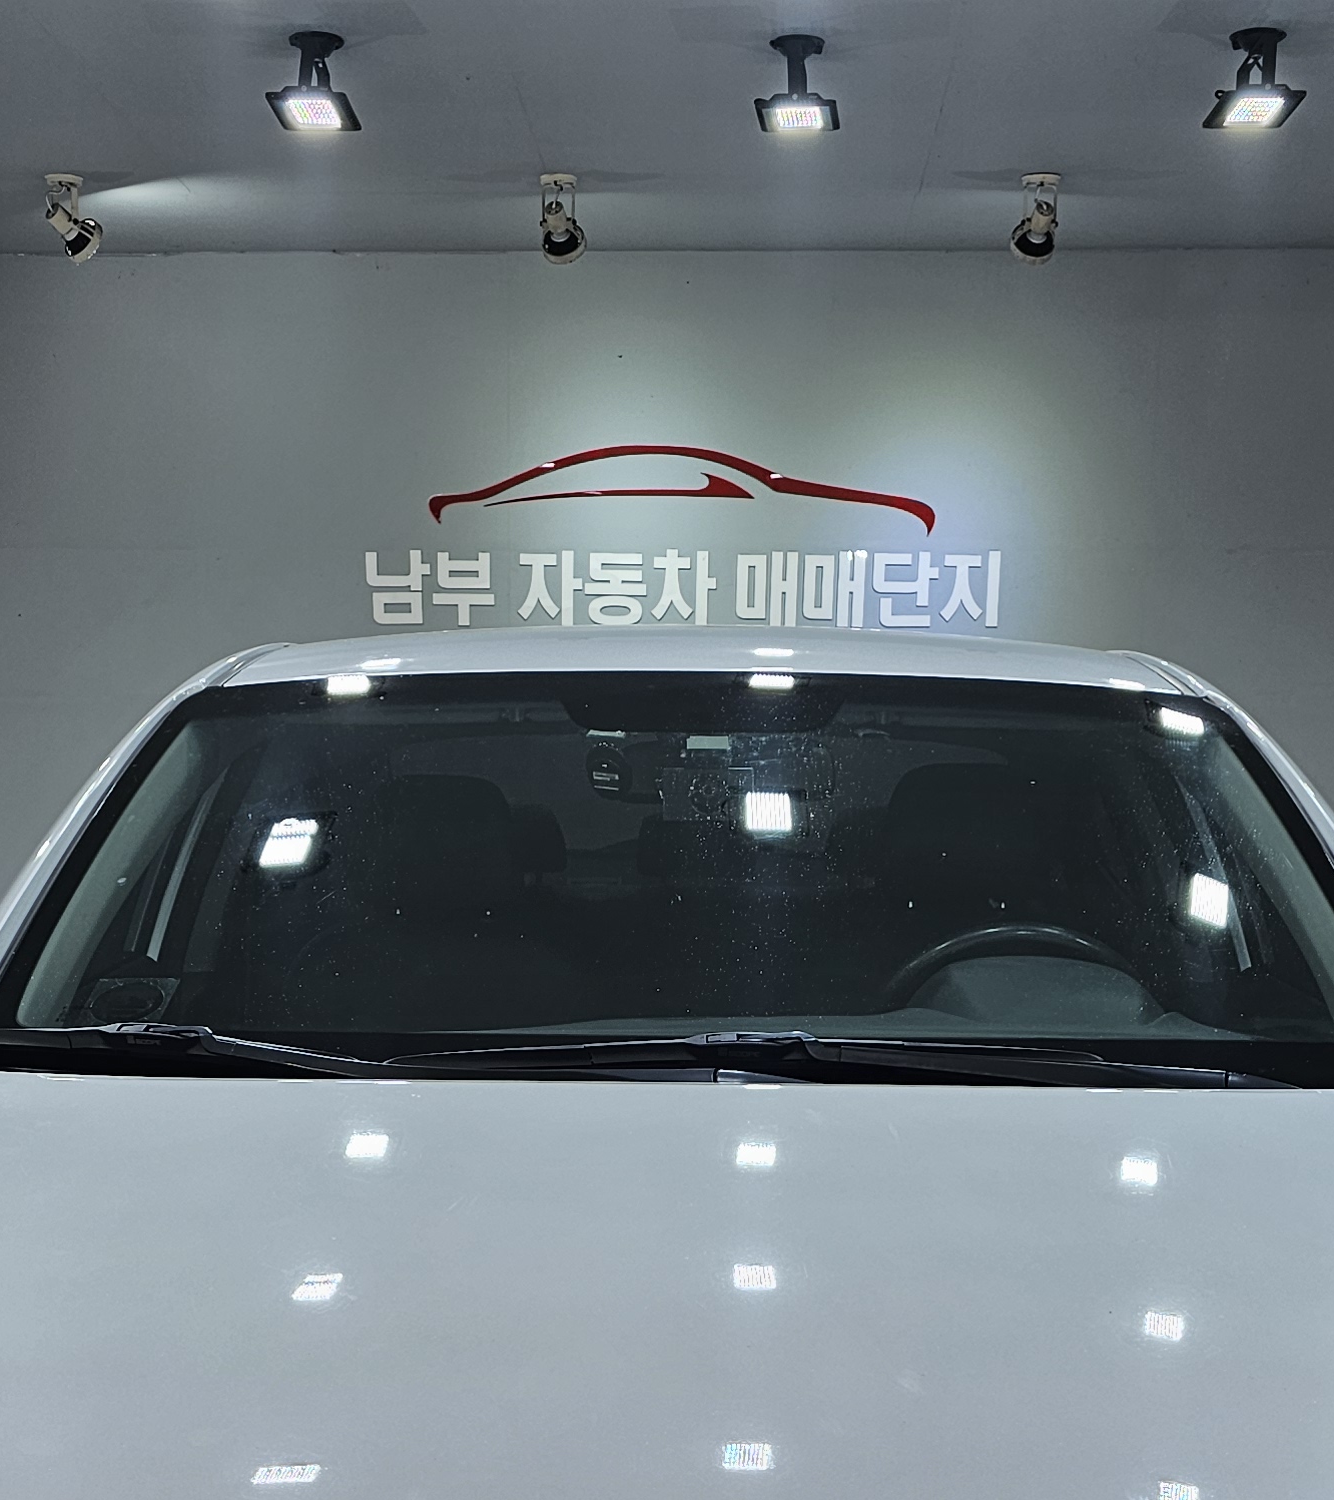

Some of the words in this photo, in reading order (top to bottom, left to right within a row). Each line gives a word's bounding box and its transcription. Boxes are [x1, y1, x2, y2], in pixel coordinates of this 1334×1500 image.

[365, 549, 495, 626] 남부
[517, 548, 717, 627] 자동차
[735, 549, 1001, 628] 매매단지
